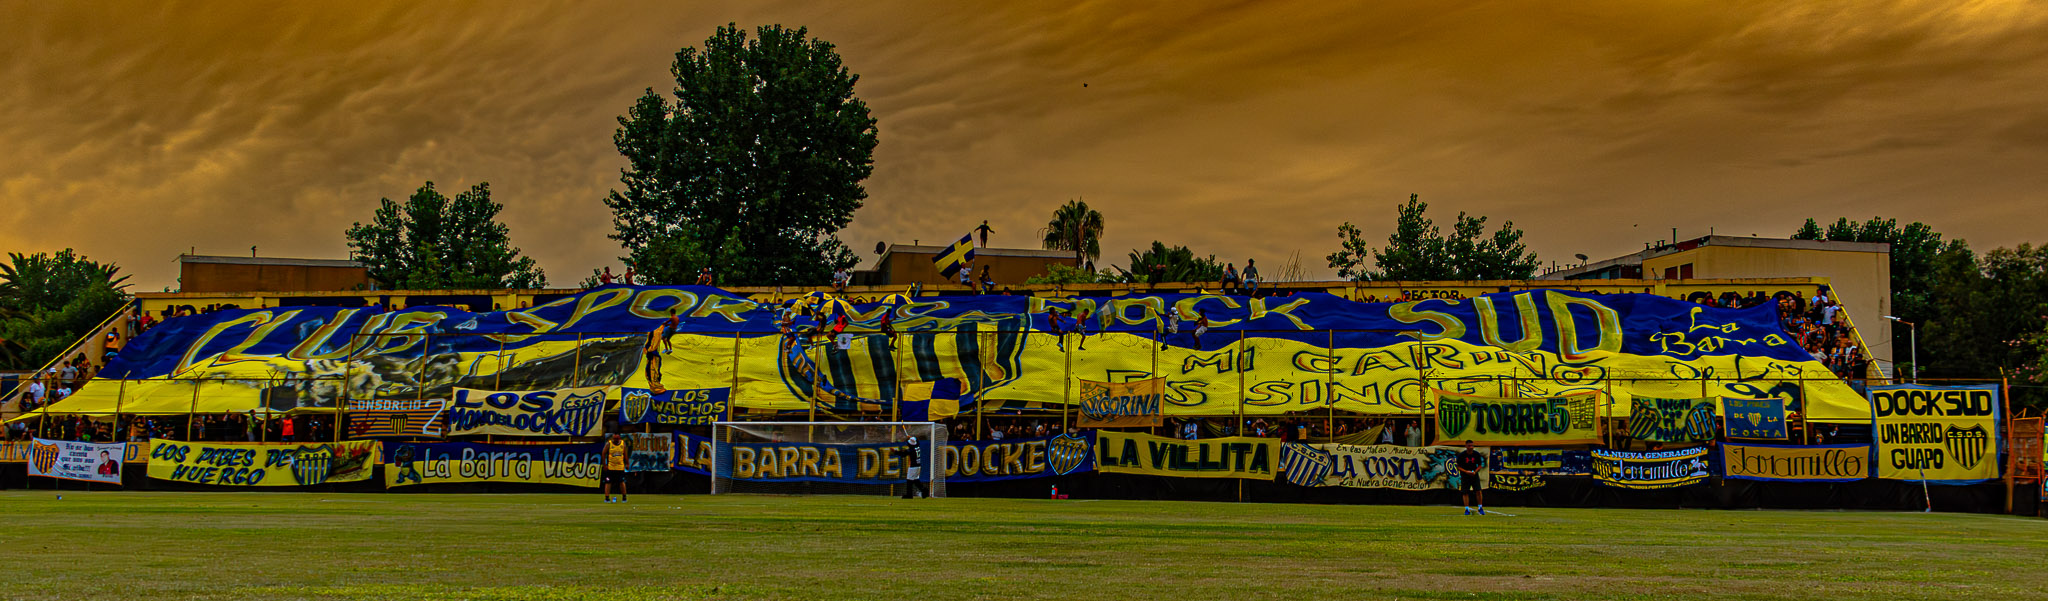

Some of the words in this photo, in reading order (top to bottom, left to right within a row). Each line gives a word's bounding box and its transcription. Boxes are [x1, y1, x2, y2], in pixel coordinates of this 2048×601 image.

[1404, 290, 1460, 301] ECTOR
[1689, 306, 1741, 333] La
[167, 308, 448, 380] CLUB
[1386, 289, 1623, 364] SUD
[1649, 331, 1787, 355] Barra
[1182, 345, 1255, 374] MI
[455, 389, 557, 412] LOS
[650, 400, 727, 416] WACHOS
[671, 389, 710, 403] LOS
[1873, 390, 1946, 418] DOCK
[1946, 390, 1993, 417] SUD
[349, 399, 421, 410] CONSORCIO
[422, 398, 446, 436] 2
[449, 406, 569, 435] MONOBLOCK
[656, 413, 719, 425] CRECEN
[1471, 402, 1549, 435] TORRE
[1548, 397, 1570, 435] 5
[1730, 427, 1782, 438] COSTA
[1881, 423, 1901, 444] UN
[1901, 422, 1943, 444] BARRIO
[152, 443, 190, 463] LOS
[196, 447, 257, 467] PIBES
[265, 448, 297, 469] DE
[423, 447, 451, 479] La
[460, 447, 532, 481] Barra
[678, 434, 713, 471] LA
[732, 446, 843, 480] BARRA
[938, 440, 1046, 478] DOCKE
[1099, 436, 1142, 468] LA
[1148, 440, 1271, 475] VILLITA
[1597, 448, 1610, 457] LA
[1611, 450, 1644, 459] NUEVA
[1645, 446, 1702, 459] GENERACION
[1732, 446, 1864, 478] Jaramillo
[1891, 448, 1944, 471] GUAPO
[171, 464, 265, 485] HUERGO
[1331, 454, 1358, 478] LA
[1365, 456, 1422, 480] COSTA
[1612, 459, 1688, 481] Jaramillo
[1340, 477, 1354, 486] La
[1357, 477, 1380, 487] Nueva
